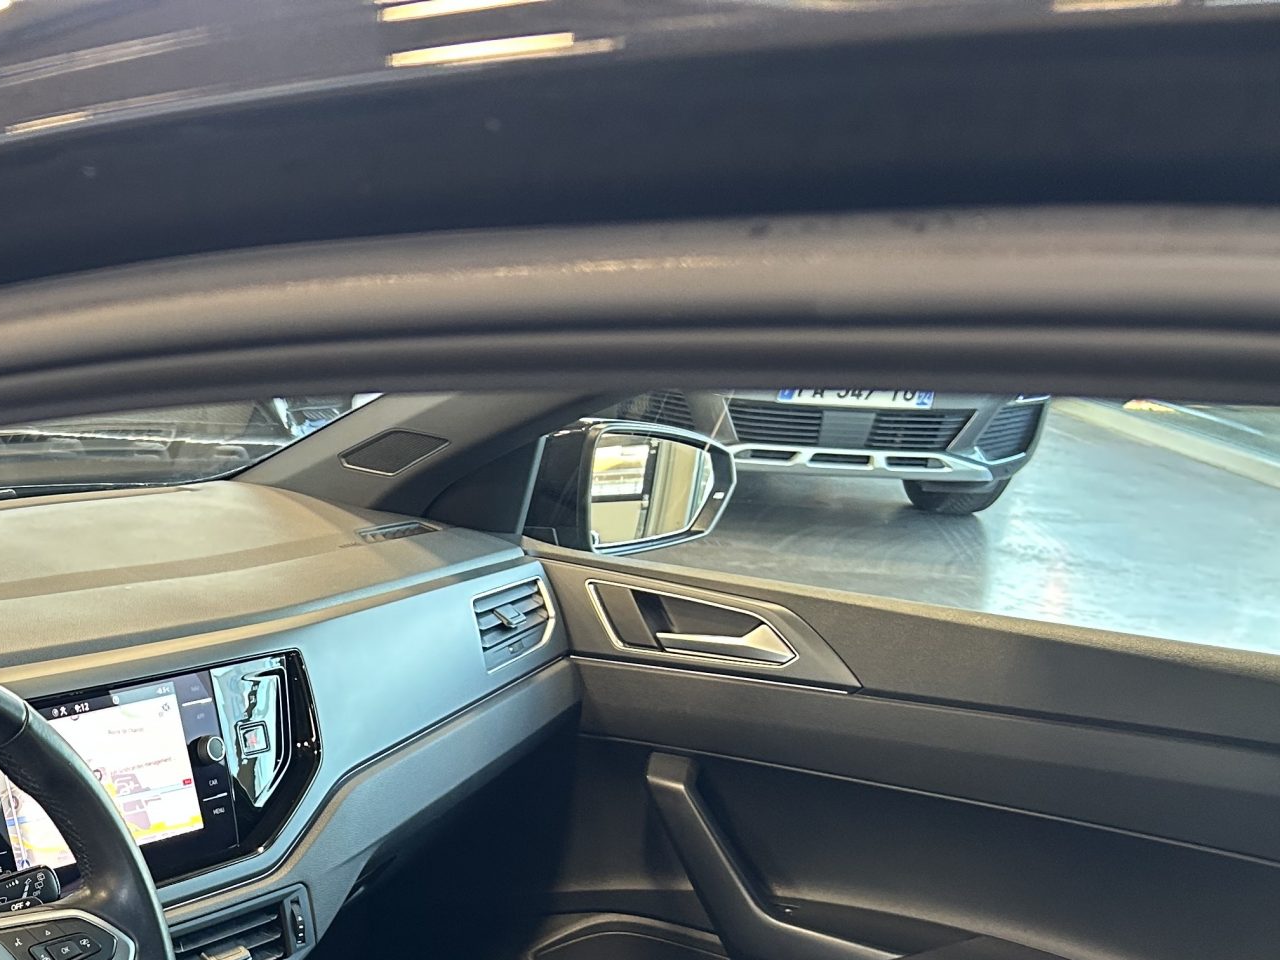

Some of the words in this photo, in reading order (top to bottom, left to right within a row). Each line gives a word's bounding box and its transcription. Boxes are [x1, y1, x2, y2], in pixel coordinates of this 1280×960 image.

[74, 702, 90, 713] 9:12
[213, 807, 225, 815] MENU
[10, 902, 24, 911] OFF
[60, 946, 70, 954] OK
